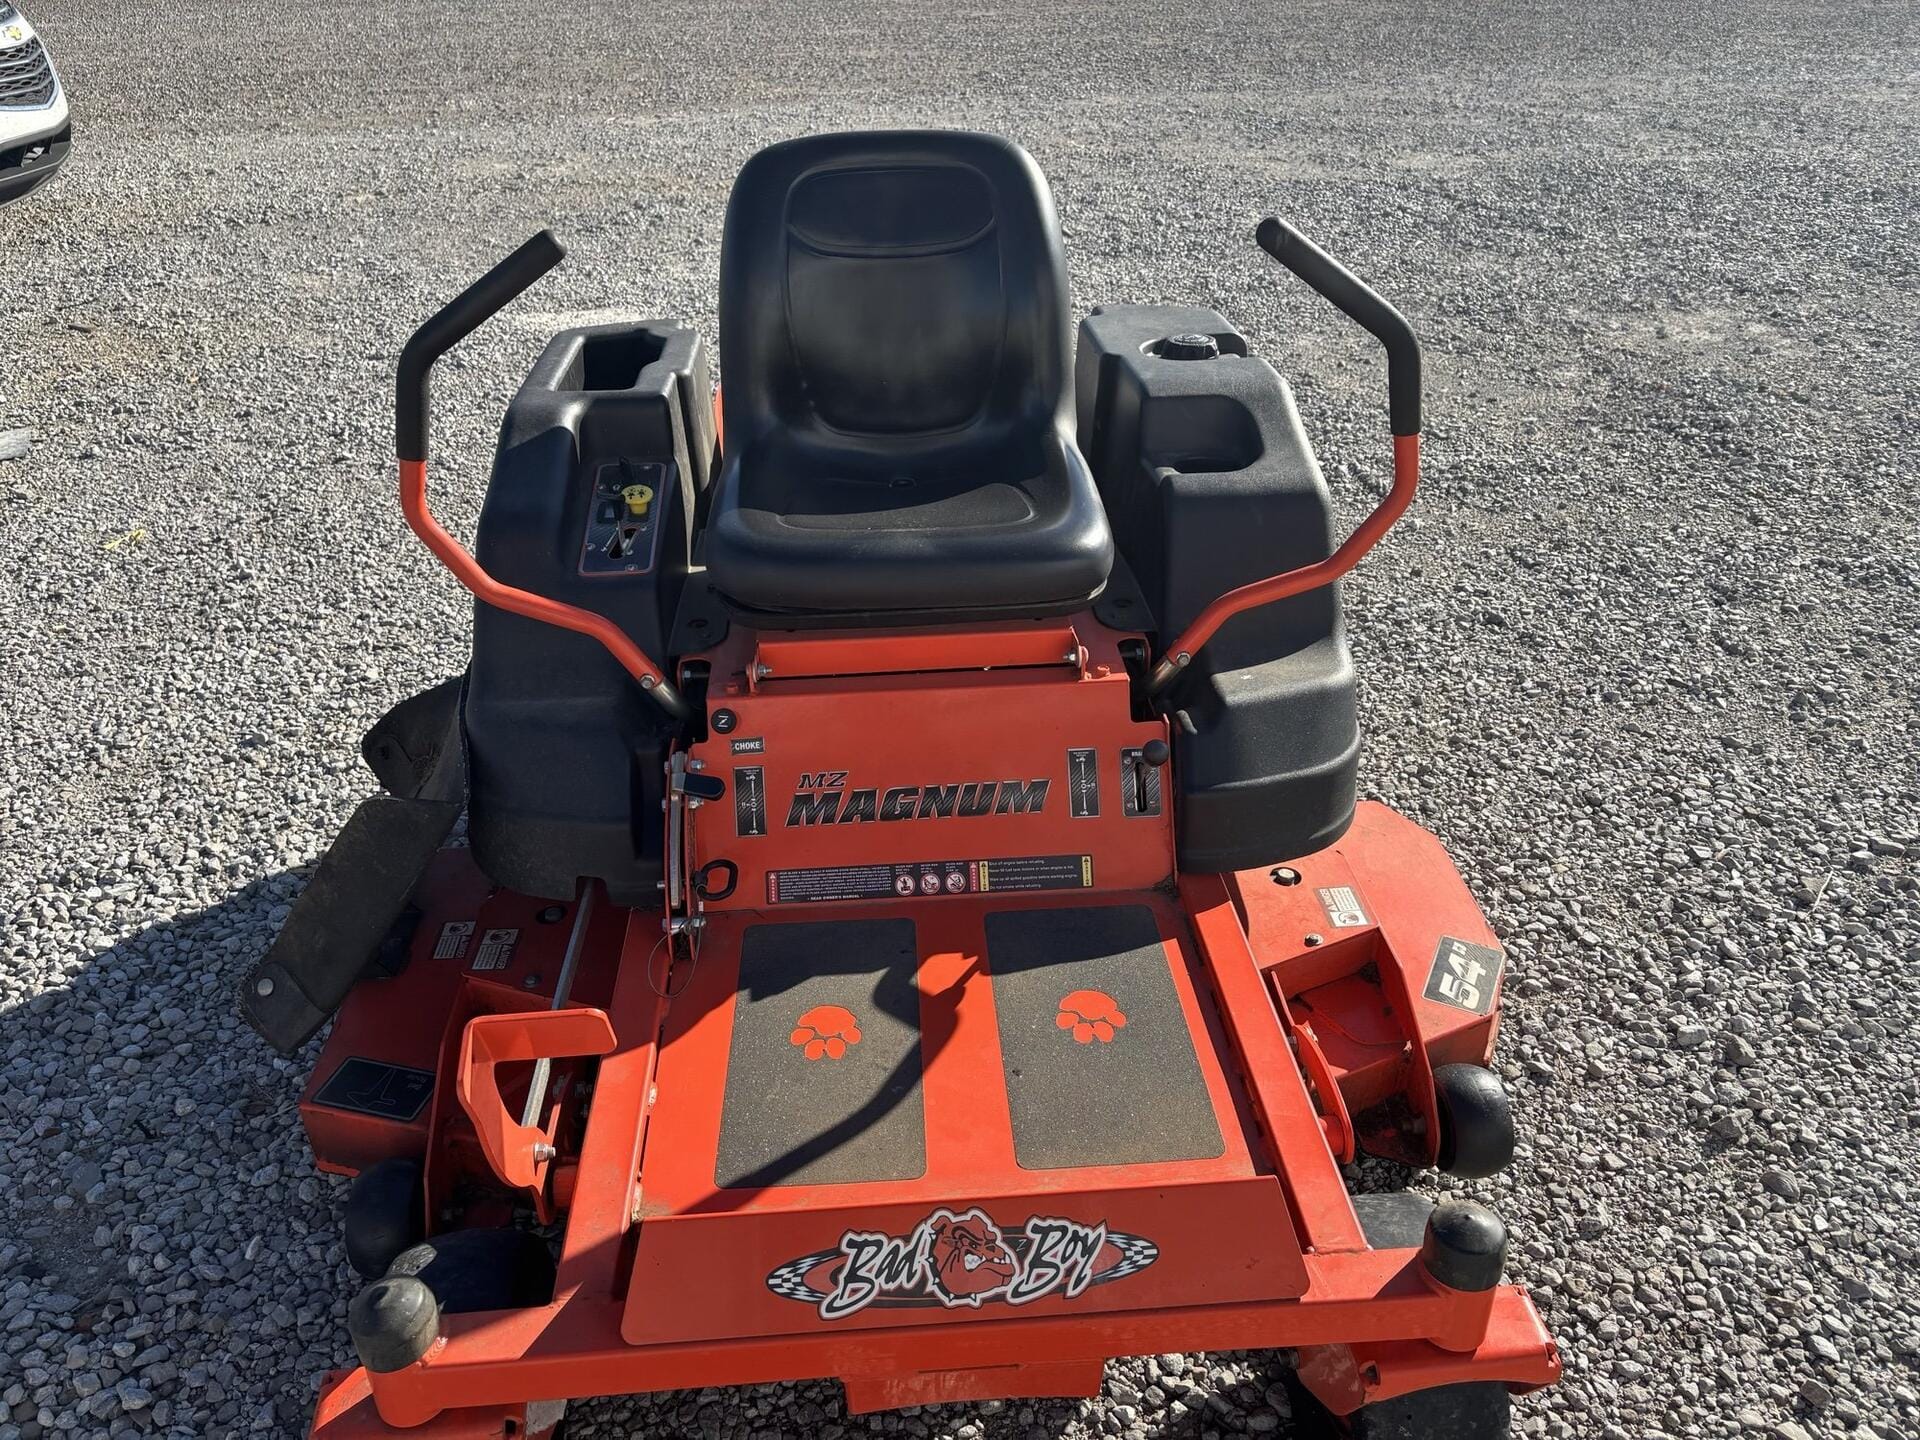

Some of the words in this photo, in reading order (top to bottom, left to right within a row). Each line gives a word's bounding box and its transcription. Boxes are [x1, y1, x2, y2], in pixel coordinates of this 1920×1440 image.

[734, 741, 761, 751] CHOKE
[797, 771, 850, 789] MZ
[785, 778, 1052, 828] MAGNUM
[820, 1224, 931, 1318] Bad
[1009, 1217, 1105, 1302] Boy
